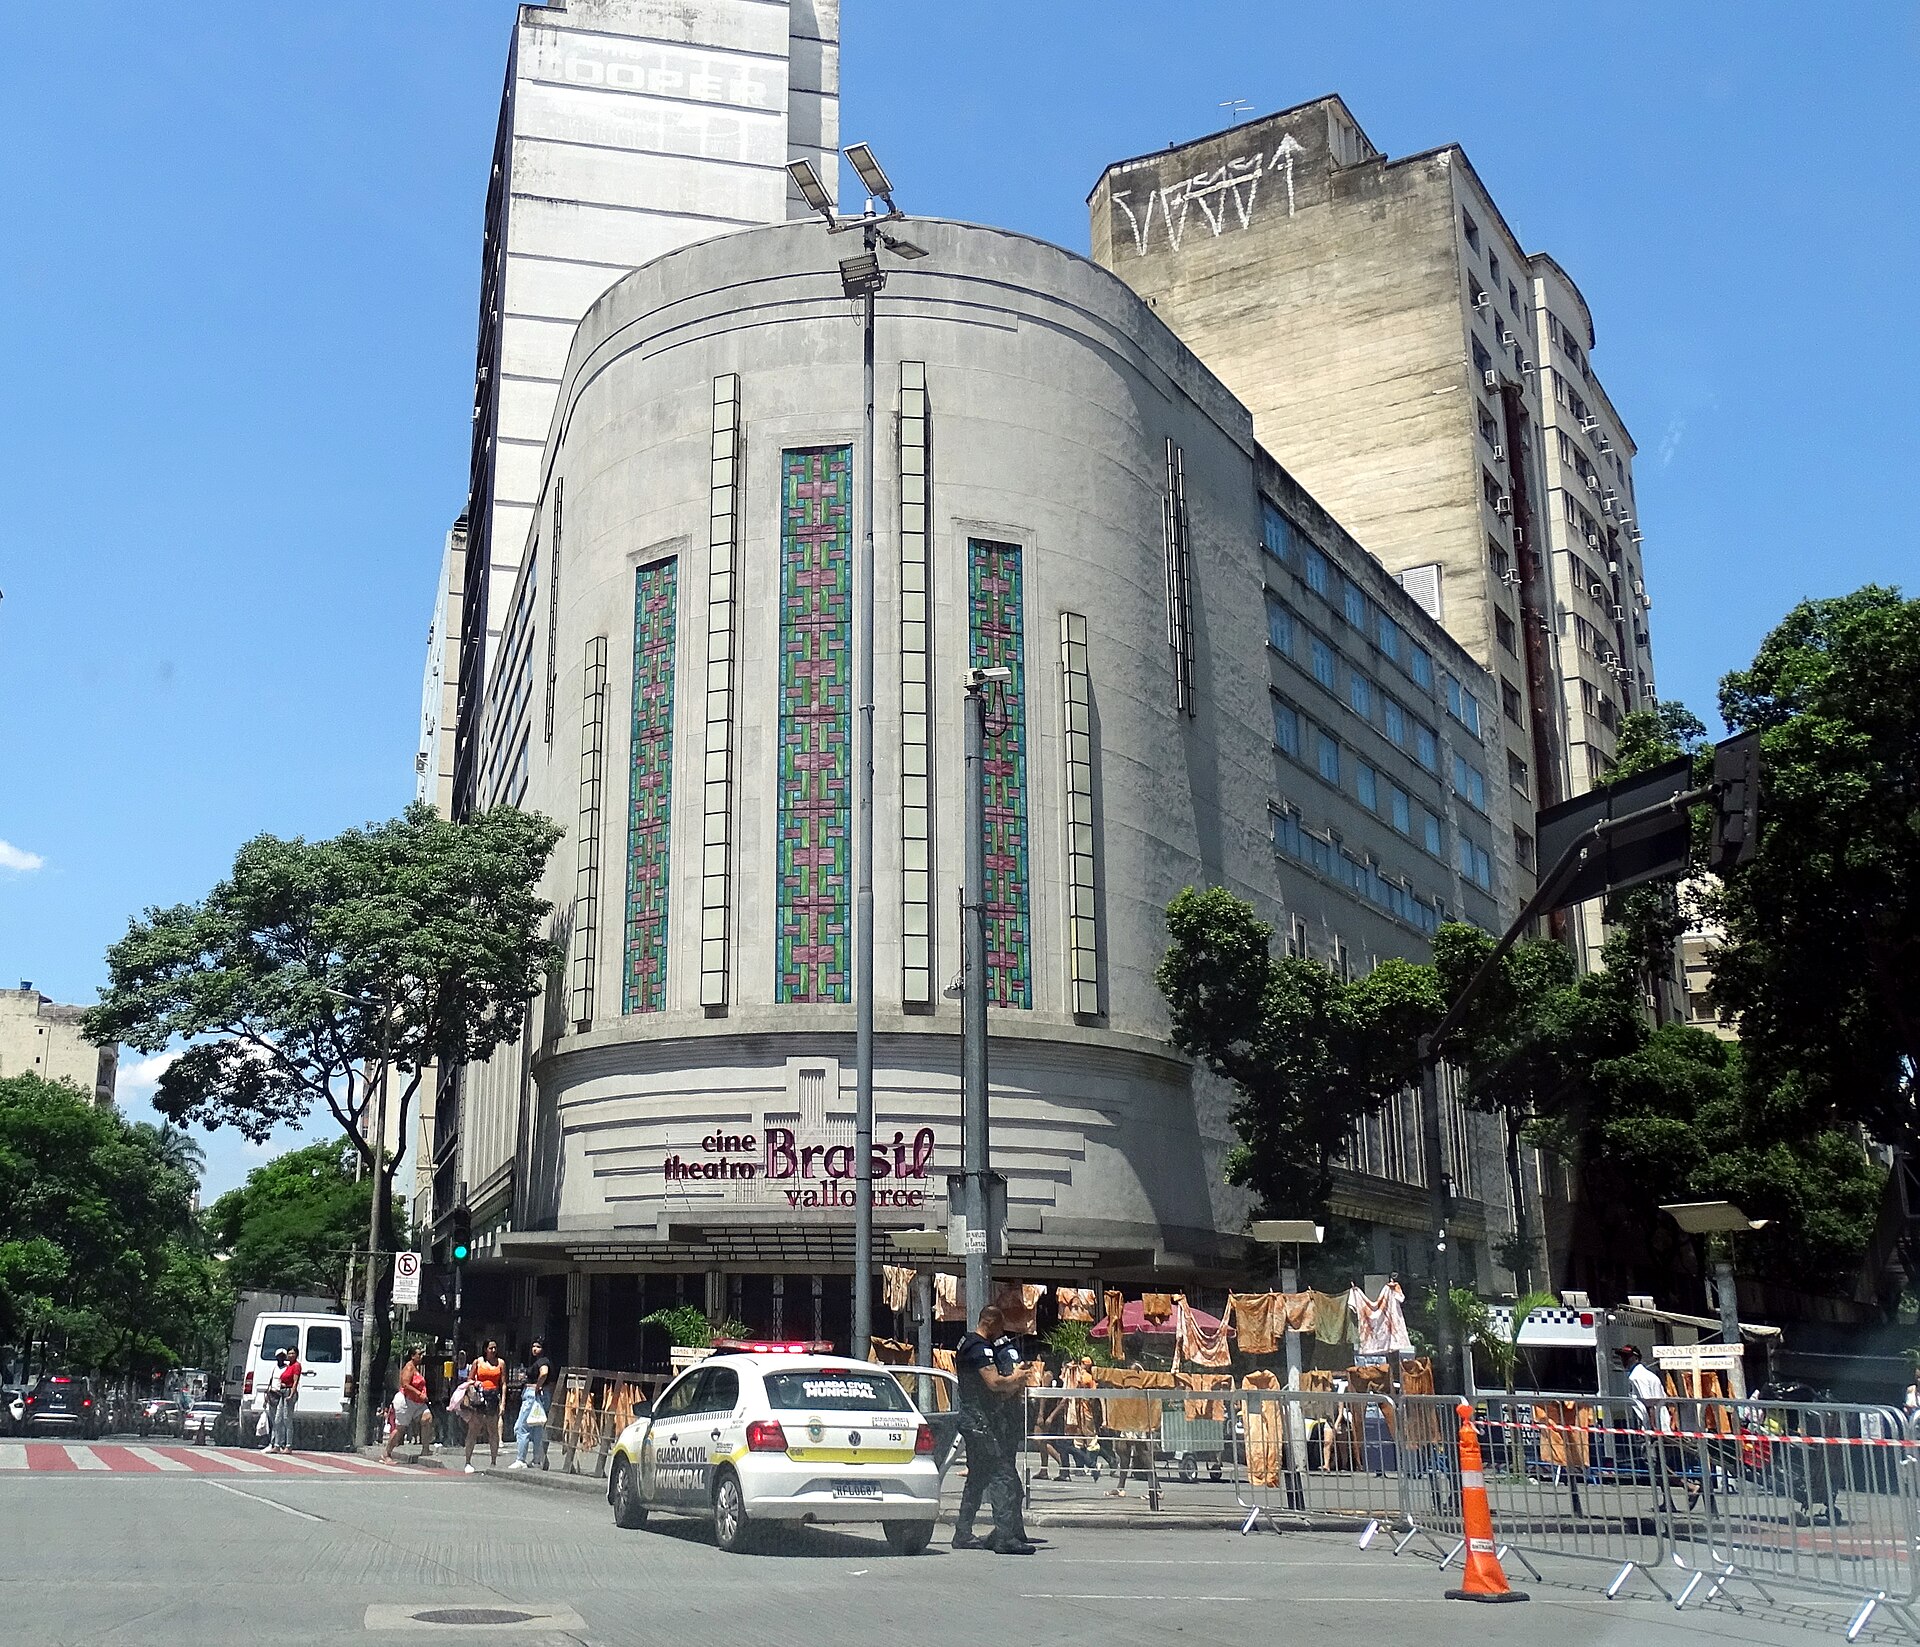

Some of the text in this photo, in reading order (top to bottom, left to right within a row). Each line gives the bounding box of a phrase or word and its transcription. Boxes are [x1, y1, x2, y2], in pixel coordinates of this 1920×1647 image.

[702, 1129, 756, 1152] cine
[764, 1127, 935, 1178] Brasil
[664, 1155, 755, 1179] theatro
[784, 1180, 923, 1207] vallorec
[802, 1380, 874, 1390] GUARDA CIVIL
[806, 1387, 877, 1399] MUNICIPAL
[888, 1433, 902, 1441] 153
[656, 1447, 686, 1463] GUARDA
[687, 1446, 707, 1462] CIVIL
[656, 1468, 705, 1490] MUNICIPAL
